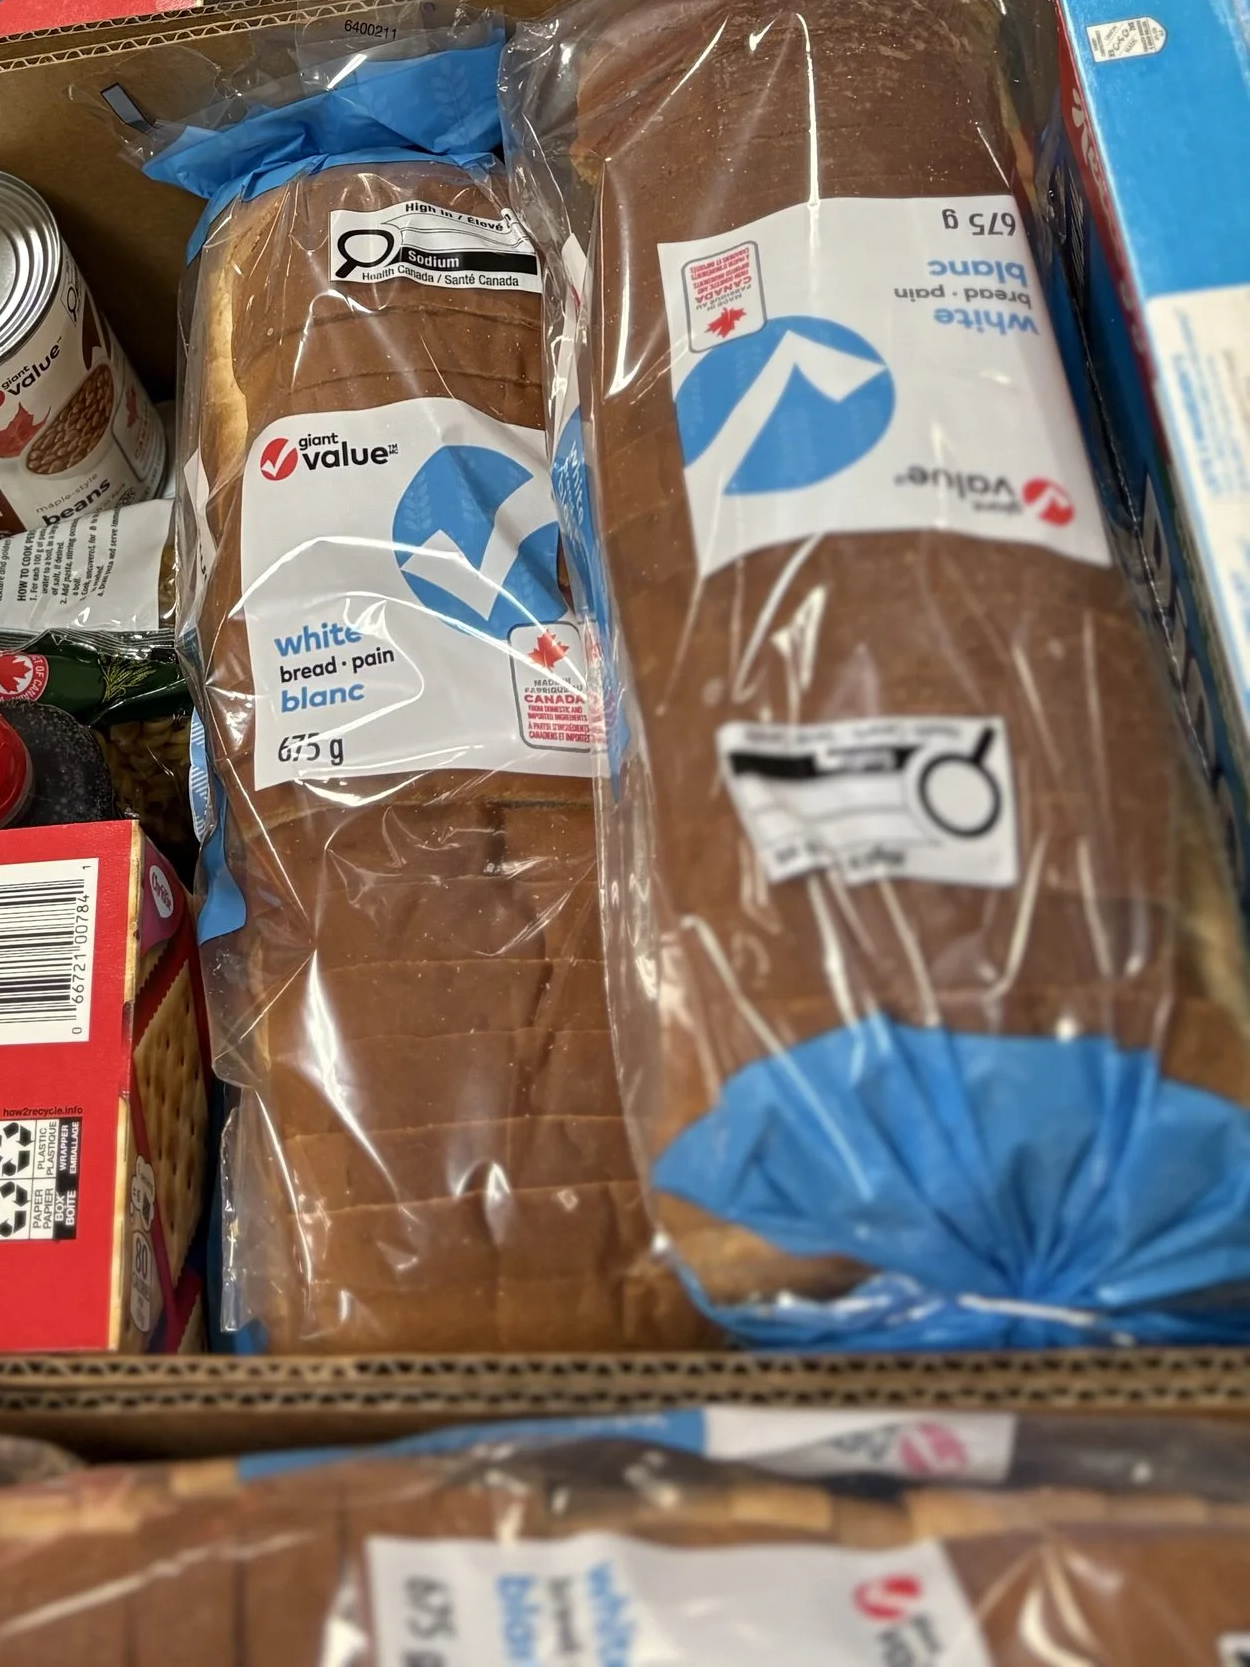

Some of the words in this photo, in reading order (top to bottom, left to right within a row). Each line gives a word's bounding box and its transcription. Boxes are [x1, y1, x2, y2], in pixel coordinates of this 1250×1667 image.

[344, 19, 398, 40] 6400211
[405, 202, 437, 220] High
[467, 214, 504, 232] Élevé
[941, 208, 959, 230] g
[967, 212, 1017, 236] 675
[408, 250, 460, 269] Sodium
[927, 258, 1029, 289] blanc
[362, 267, 396, 281] Health
[397, 265, 435, 284] Canada
[444, 273, 476, 286] Santé
[478, 274, 520, 288] Canada
[694, 275, 753, 304] CANADA
[893, 286, 947, 303] pain
[964, 286, 1032, 310] bread
[933, 306, 1039, 337] white
[1, 364, 32, 391] giant
[7, 342, 63, 397] value
[298, 432, 340, 451] giant
[35, 473, 100, 514] maple-style
[42, 480, 112, 528] beans
[0, 561, 8, 575] and
[22, 548, 33, 567] COOK
[20, 567, 30, 583] TO
[61, 582, 71, 597] Add
[17, 583, 28, 603] HOW
[274, 621, 364, 658] white
[35, 666, 45, 677] OF
[279, 655, 338, 684] bread
[351, 645, 396, 674] pain
[280, 683, 367, 715] blanc
[523, 693, 586, 705] CANADA
[277, 732, 322, 763] 675
[328, 736, 346, 767] g
[75, 894, 90, 945] 00784
[71, 953, 87, 1004] 66721
[71, 1026, 83, 1035] 0
[2, 1105, 84, 1118] how2recycle.info
[37, 1126, 48, 1171] PLASTIC
[46, 1120, 57, 1176] PLASTIQUE
[59, 1124, 69, 1172] WRAPPER
[69, 1120, 80, 1175] EMBALLAGE
[32, 1188, 44, 1229] PAPER
[42, 1187, 54, 1230] PAPIER
[54, 1194, 66, 1222] BOX
[63, 1189, 77, 1226] BOÎTE
